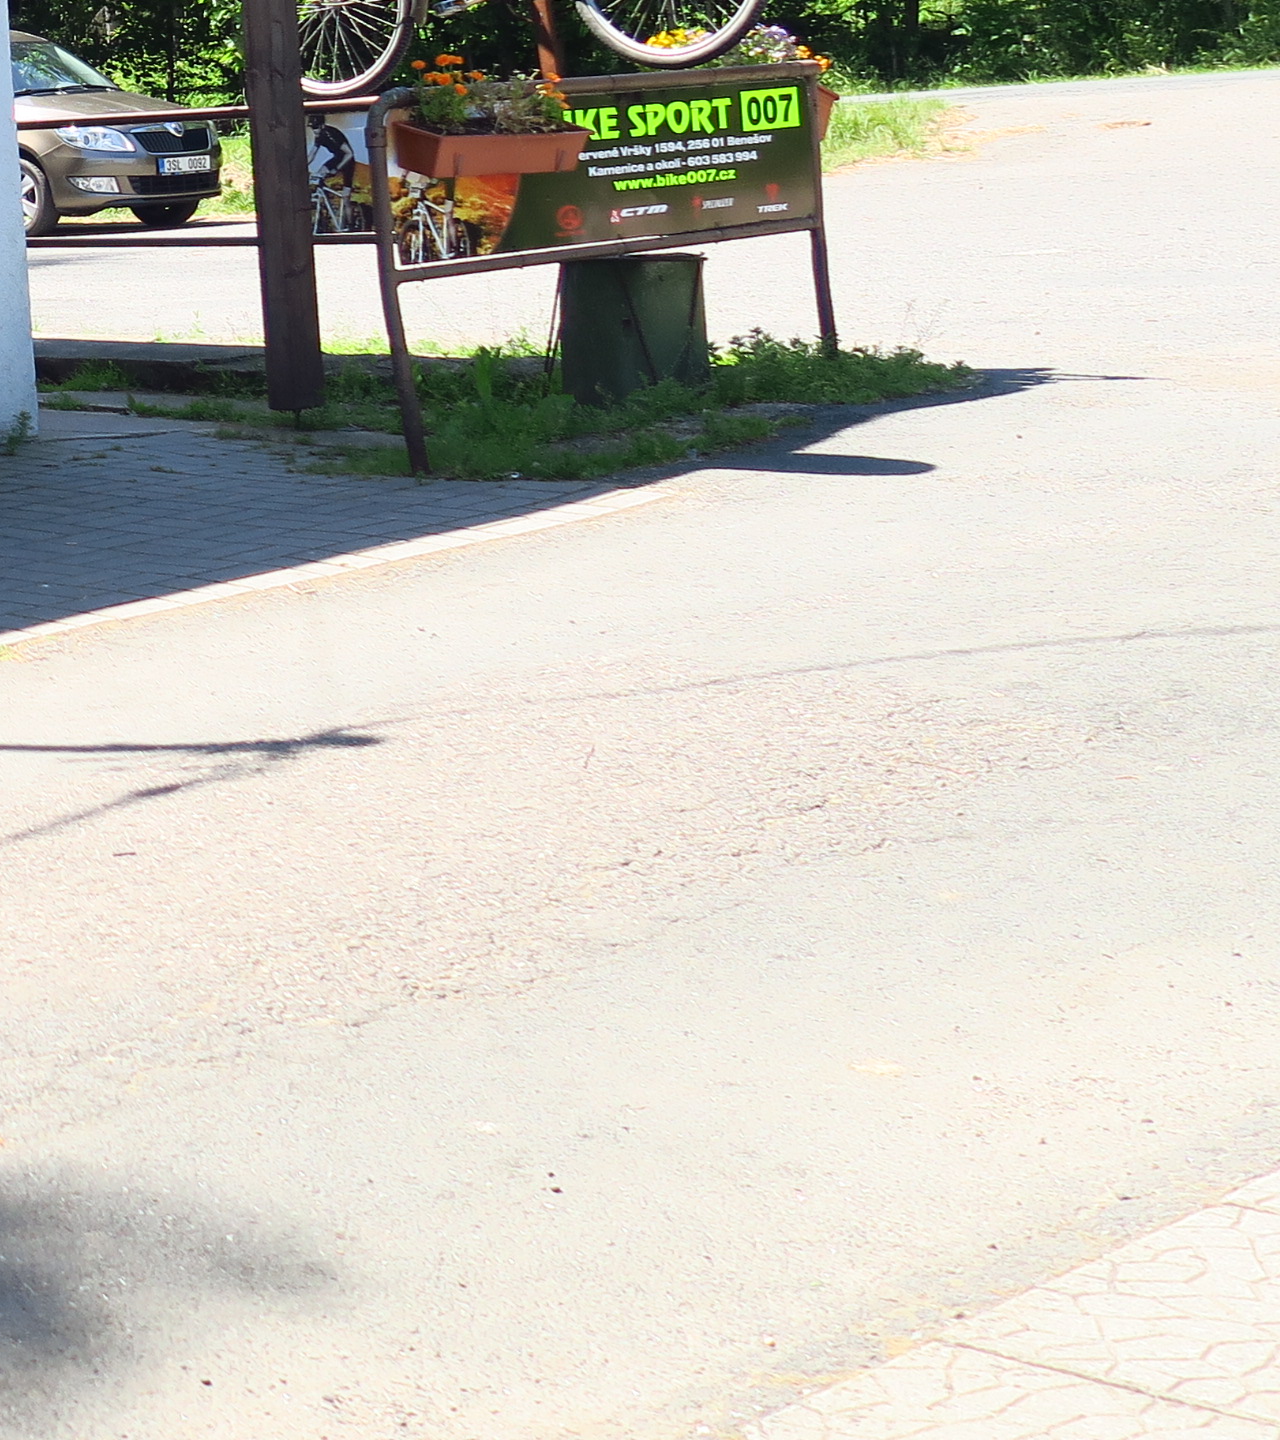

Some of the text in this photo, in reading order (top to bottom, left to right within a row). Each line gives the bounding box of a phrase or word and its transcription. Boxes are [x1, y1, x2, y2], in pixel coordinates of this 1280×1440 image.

[627, 97, 732, 138] SPORT
[747, 93, 793, 126] 007
[578, 133, 772, 161] ervené Vršky 1594, 256 01 Benešov
[188, 157, 207, 169] 0092
[588, 163, 645, 177] Kamenice
[646, 163, 654, 172] a
[655, 159, 681, 172] okolí
[687, 156, 710, 167] 603
[712, 153, 733, 165] 583
[735, 150, 757, 162] 994
[613, 168, 736, 191] www.bike007.cz
[757, 203, 788, 213] TREK
